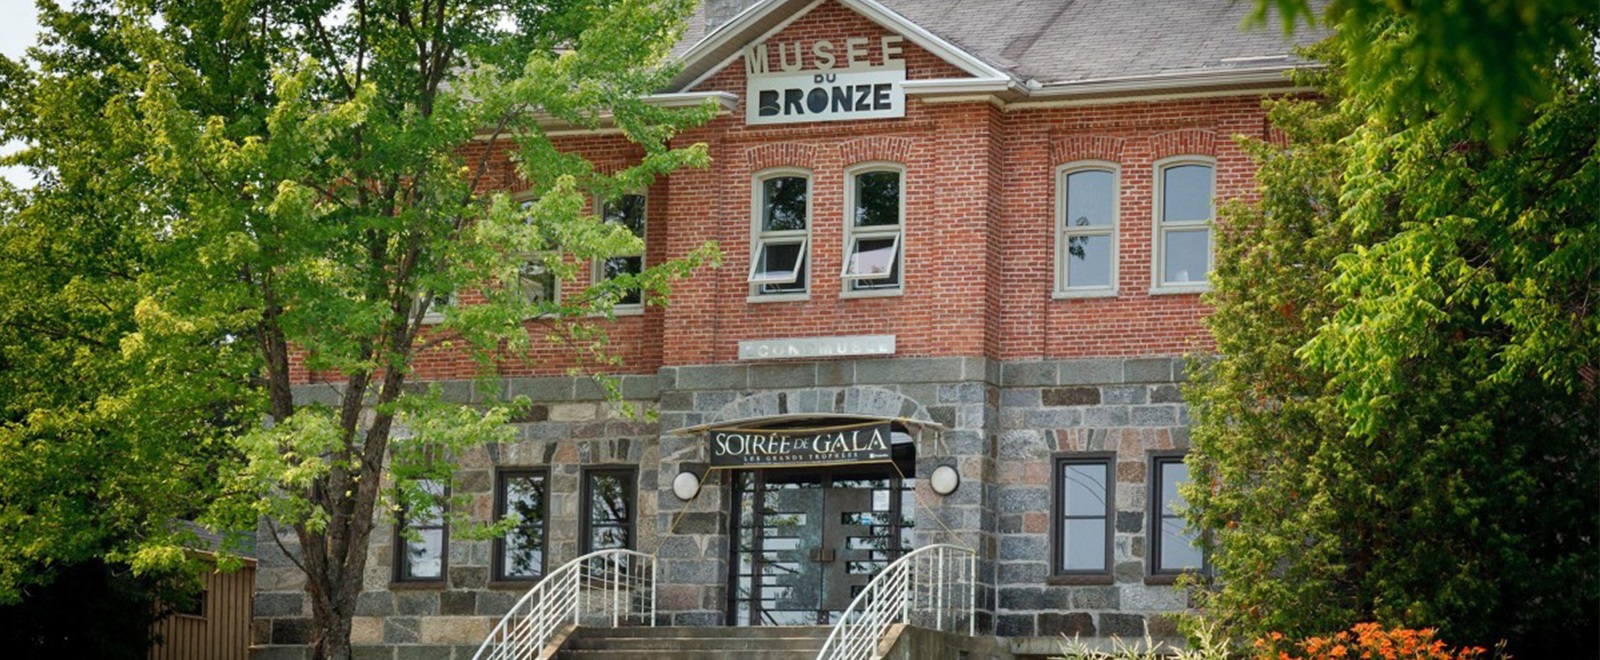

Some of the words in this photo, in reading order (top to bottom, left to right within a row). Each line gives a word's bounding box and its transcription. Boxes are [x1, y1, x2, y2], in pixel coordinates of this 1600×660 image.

[814, 73, 836, 84] DU
[758, 83, 892, 117] BRONZE
[715, 432, 791, 456] SOIRÉE
[793, 437, 809, 449] DE
[812, 428, 888, 454] GALA
